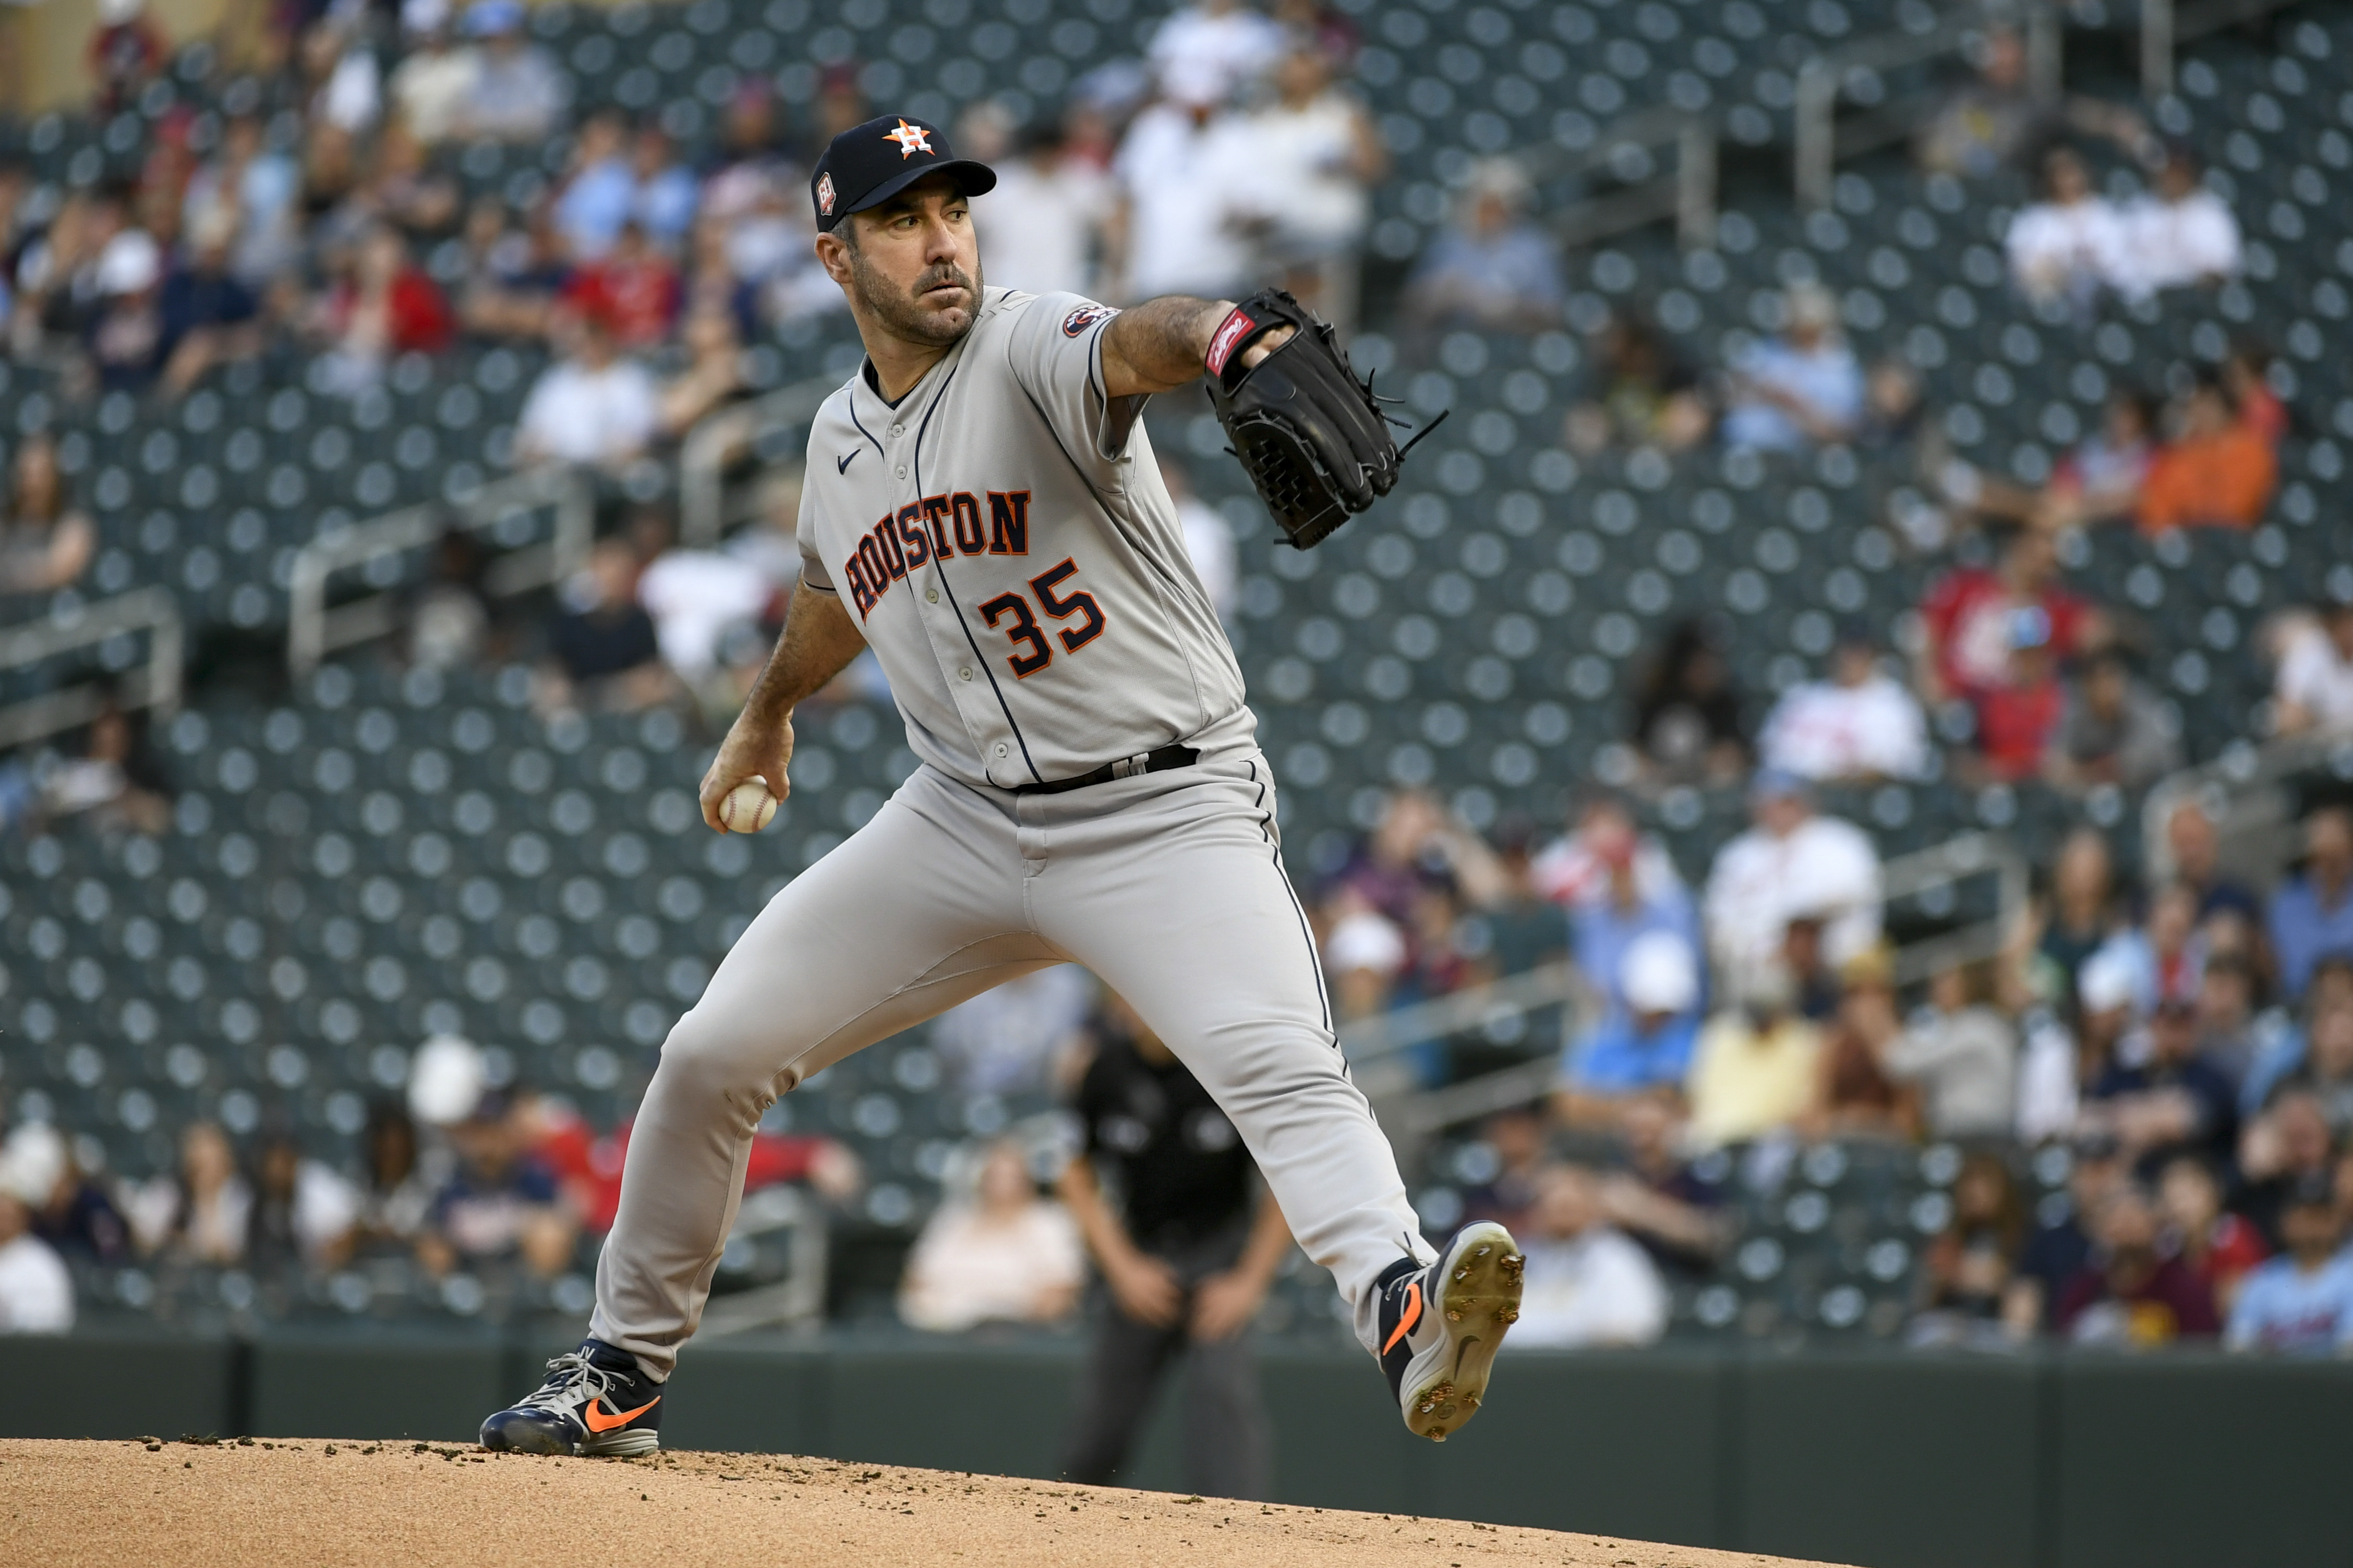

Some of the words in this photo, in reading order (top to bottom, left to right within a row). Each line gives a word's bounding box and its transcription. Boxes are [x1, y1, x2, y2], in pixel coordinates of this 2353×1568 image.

[891, 126, 931, 154] H
[818, 177, 832, 204] 60
[844, 490, 1031, 624] HOUSTON
[978, 556, 1106, 679] 35
[577, 1345, 596, 1360] JV
